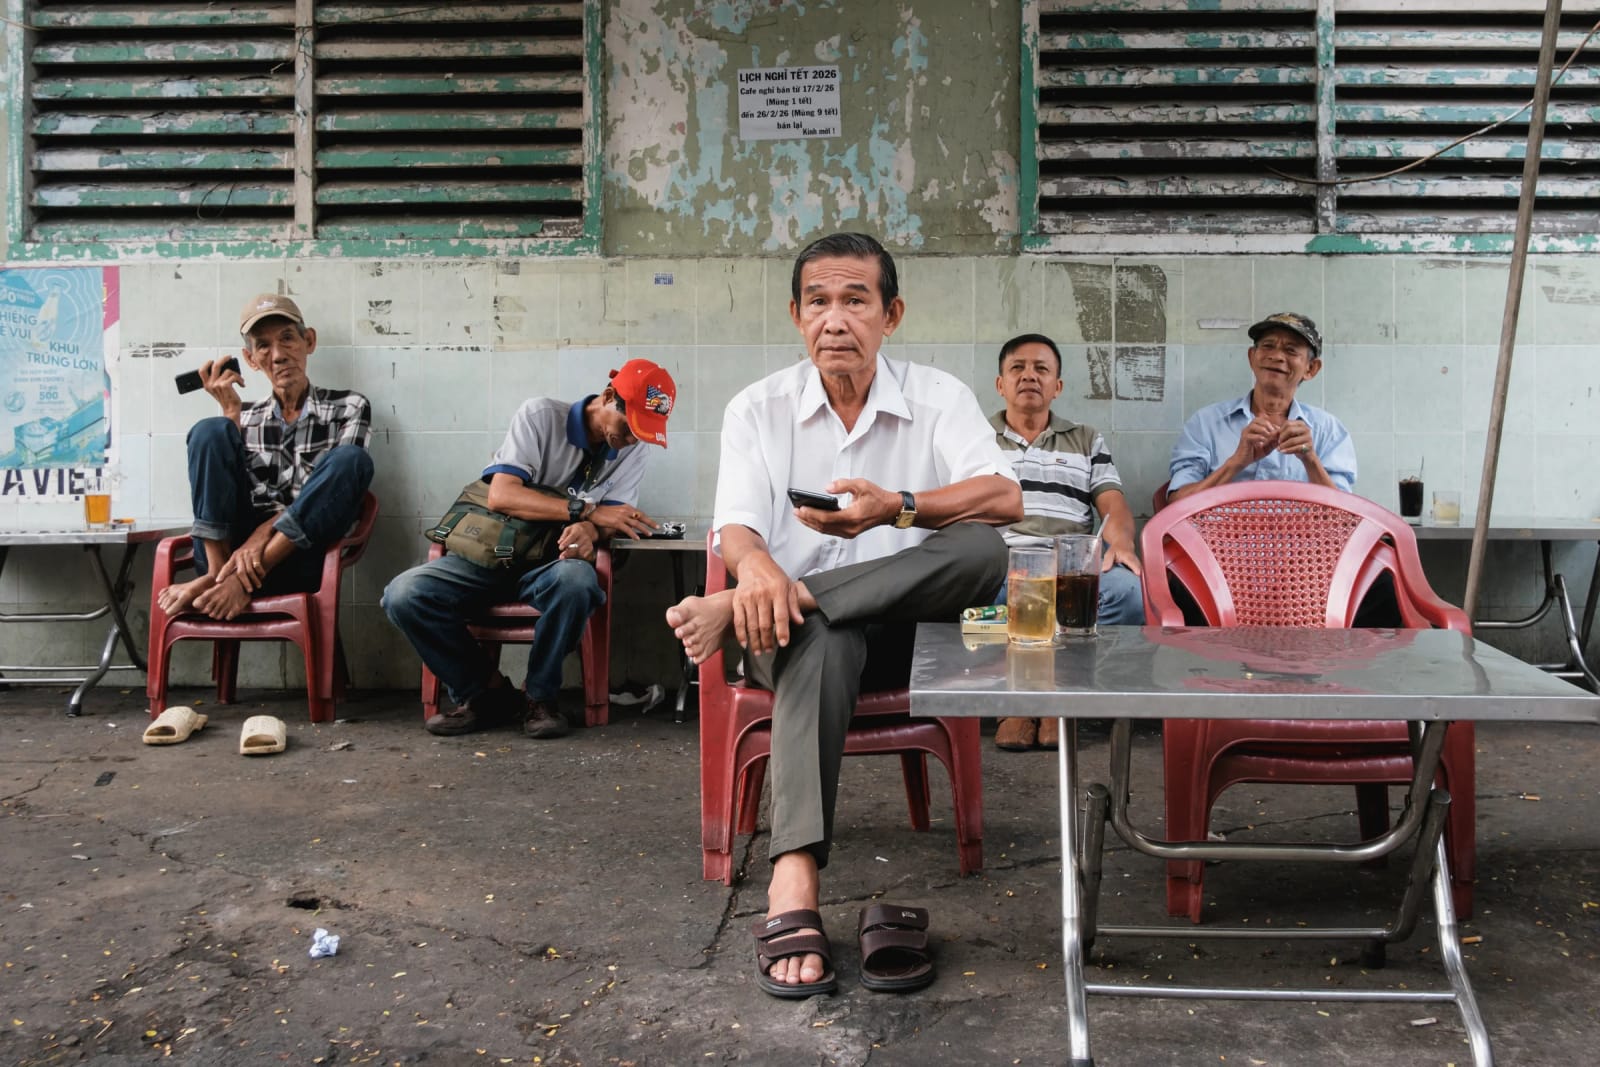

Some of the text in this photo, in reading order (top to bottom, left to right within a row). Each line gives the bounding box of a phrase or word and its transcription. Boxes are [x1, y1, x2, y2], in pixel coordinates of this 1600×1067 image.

[740, 68, 837, 84] LỊCH NGHỈ TẾT 2026
[817, 108, 822, 116] 9
[9, 326, 31, 340] VUI
[49, 341, 79, 355] KHUI
[39, 391, 59, 400] 500
[464, 526, 482, 535] US
